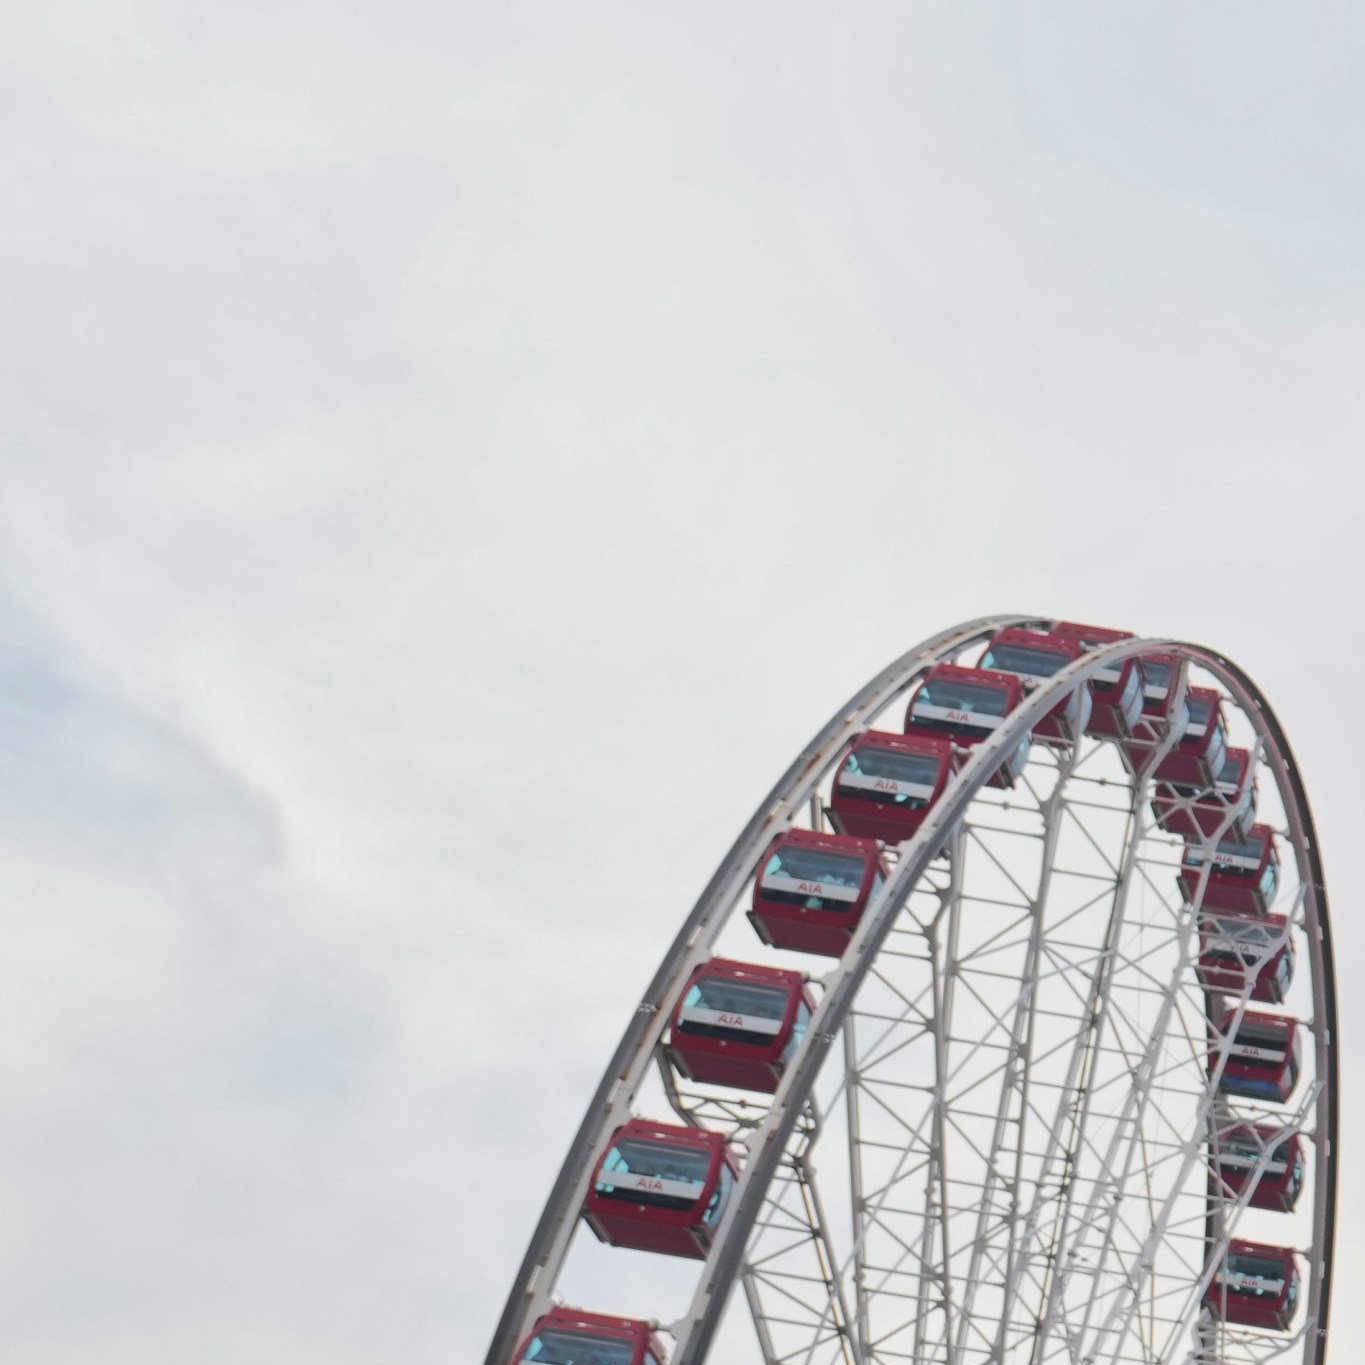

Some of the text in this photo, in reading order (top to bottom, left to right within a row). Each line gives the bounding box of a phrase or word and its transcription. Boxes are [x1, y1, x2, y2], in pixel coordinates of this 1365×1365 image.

[946, 711, 969, 721] AIA
[874, 779, 898, 792] AIA
[1215, 855, 1233, 864] AIA
[797, 882, 823, 894] AIA
[717, 1014, 743, 1027] AIA
[1242, 1047, 1259, 1057] AIA
[637, 1178, 663, 1191] AIA
